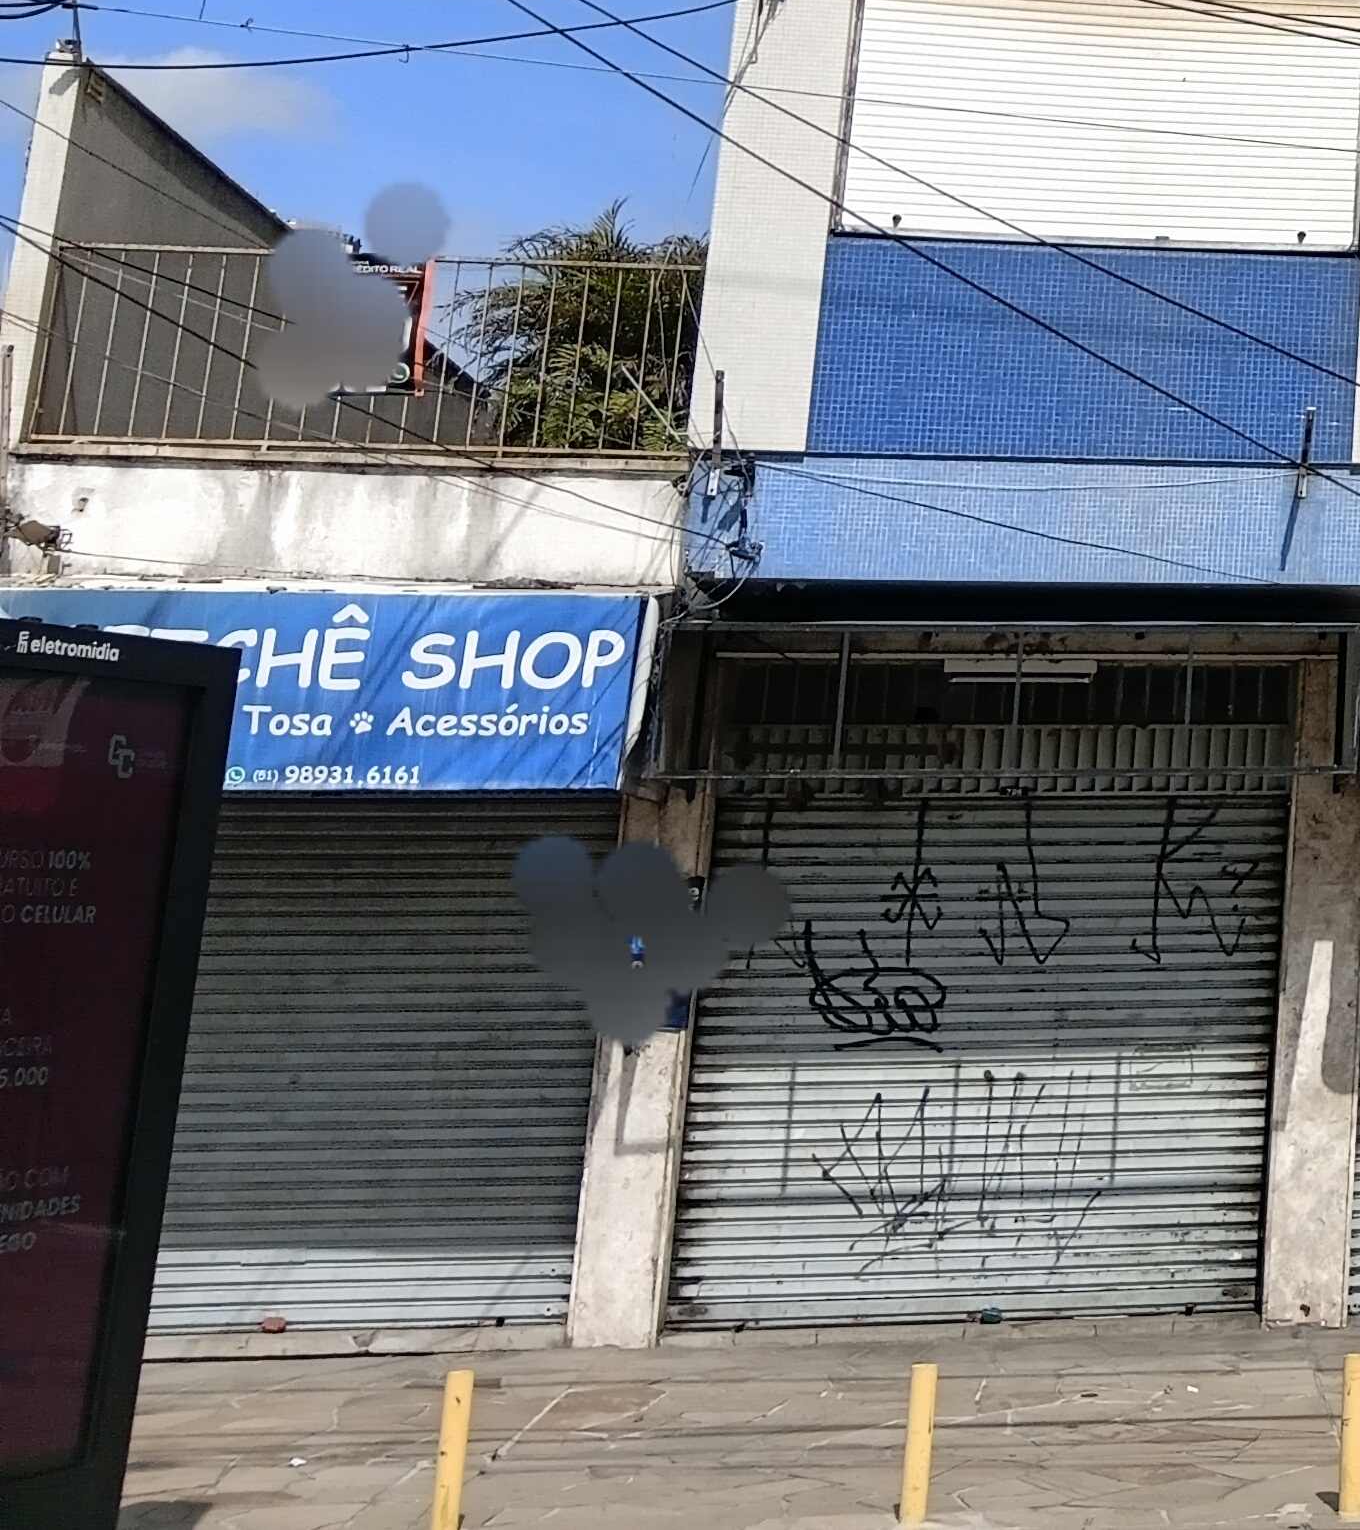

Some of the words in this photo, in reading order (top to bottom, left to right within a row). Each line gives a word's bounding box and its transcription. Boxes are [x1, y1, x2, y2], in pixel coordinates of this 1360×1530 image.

[402, 630, 625, 690] SHOP
[242, 705, 332, 736] Tosa
[386, 703, 589, 736] Acessórios
[253, 769, 279, 784] (51)
[48, 848, 92, 870] 100%
[20, 903, 97, 924] CELULAR
